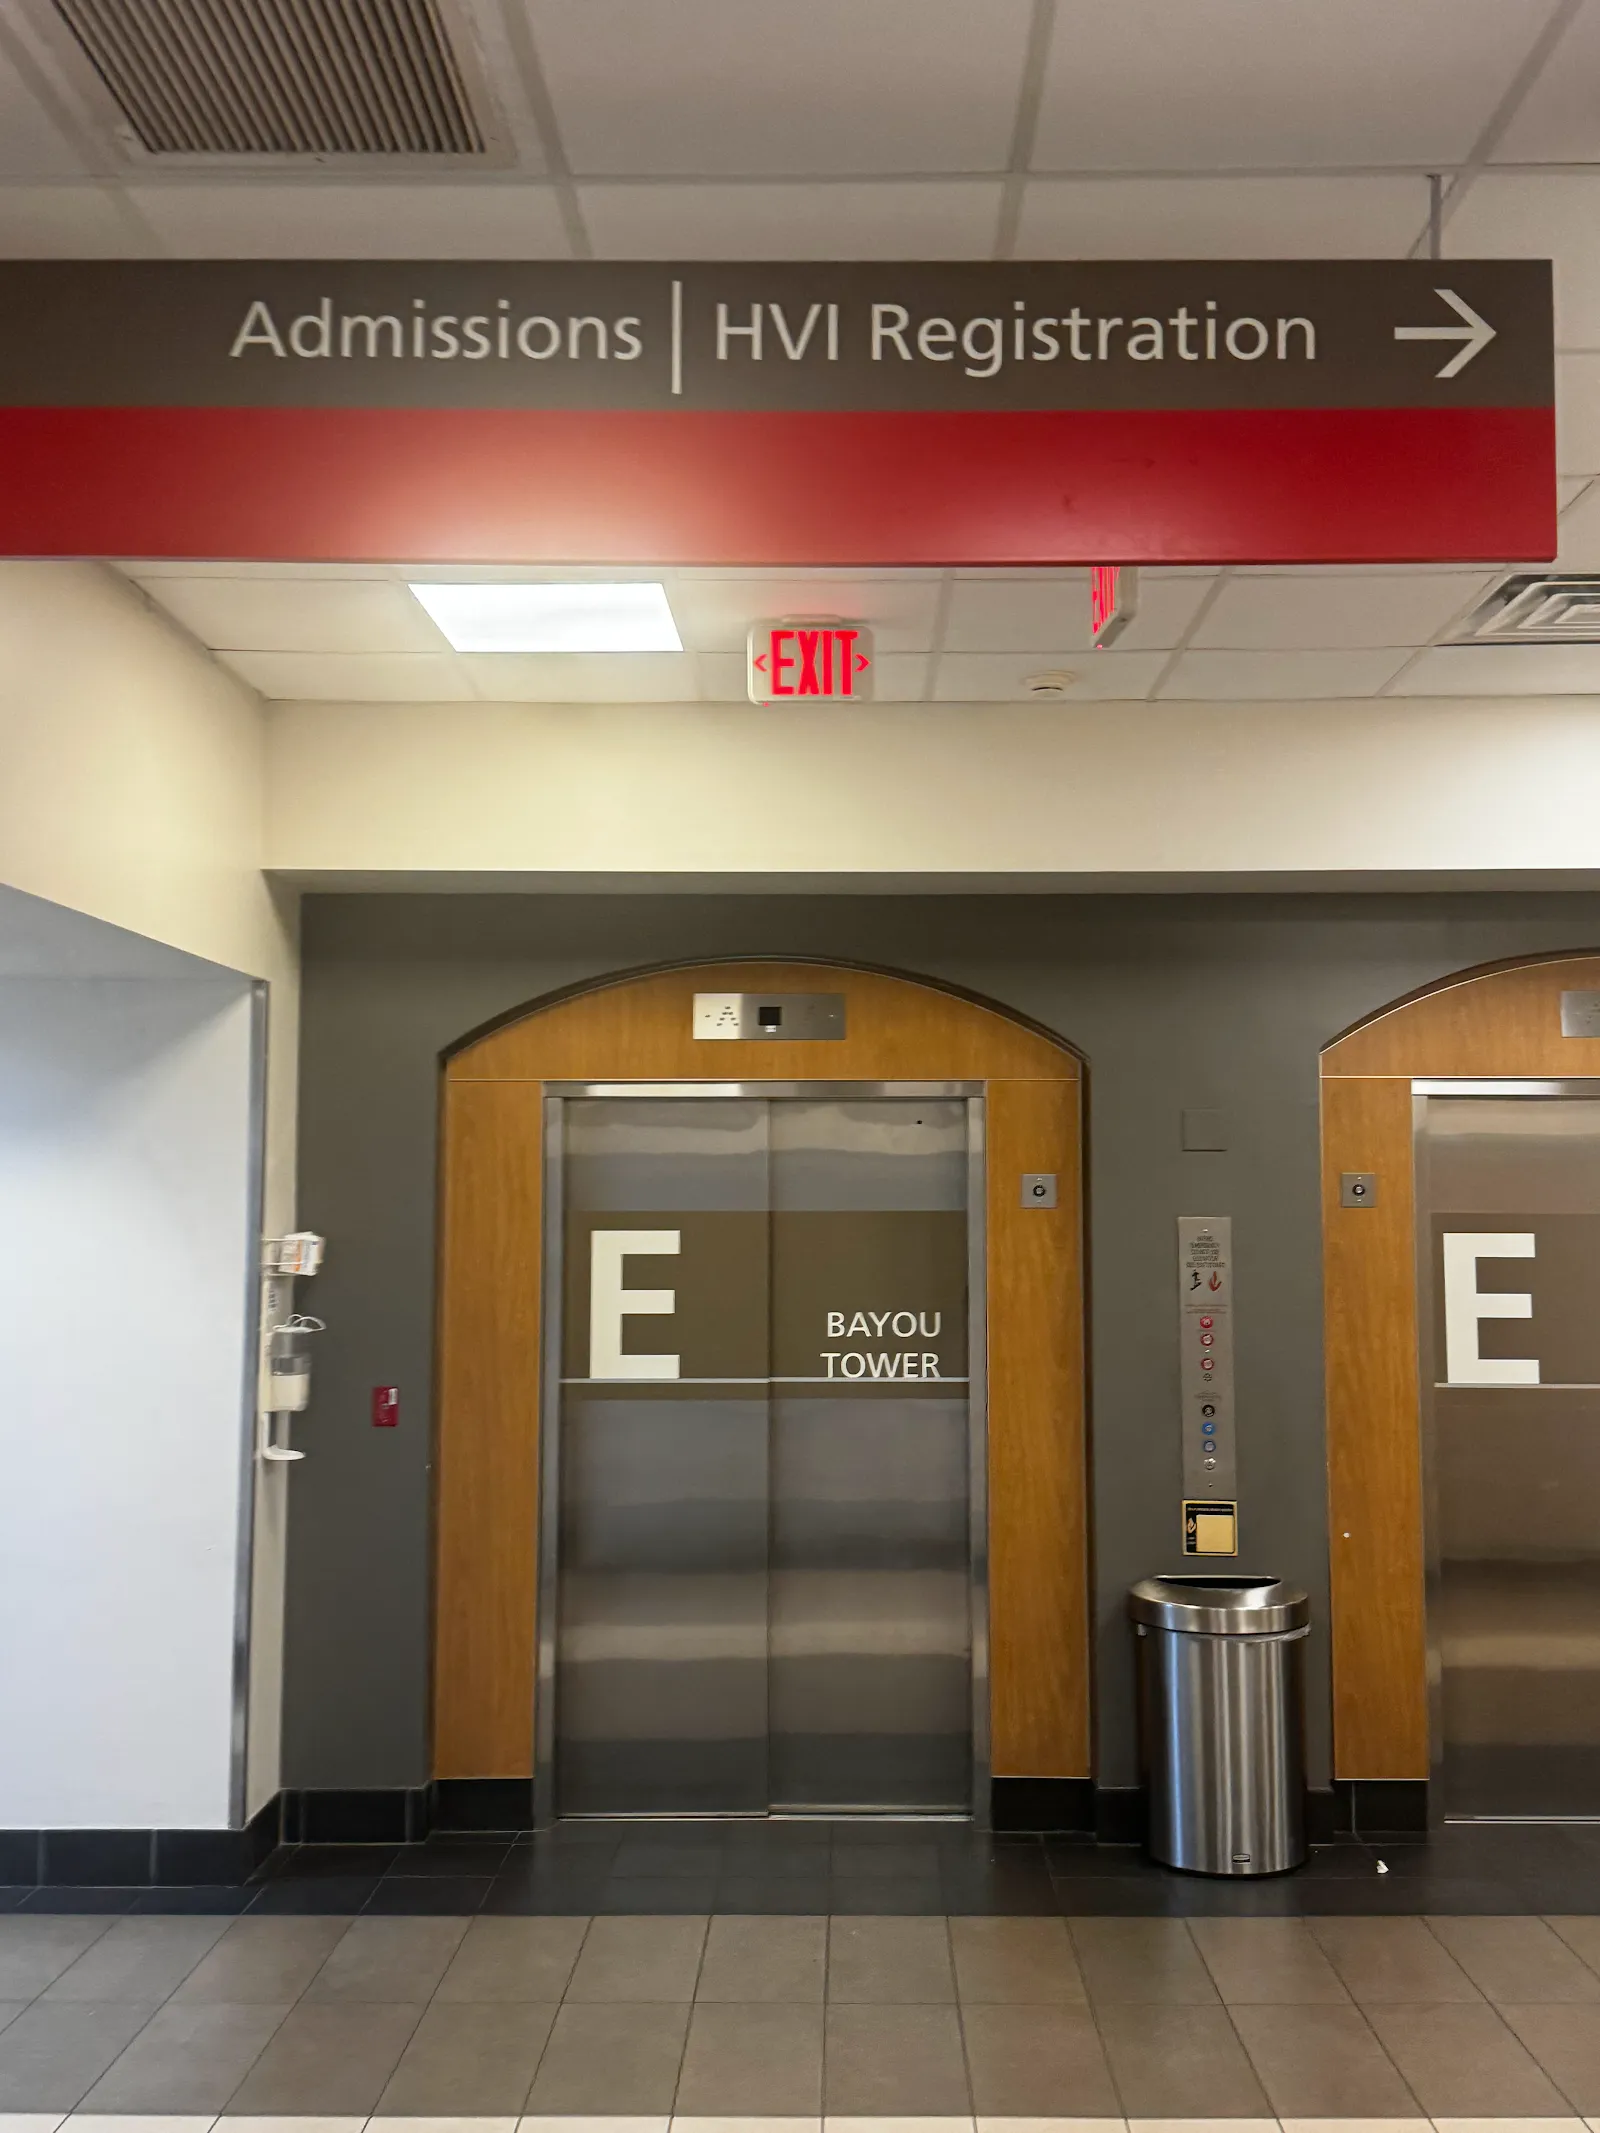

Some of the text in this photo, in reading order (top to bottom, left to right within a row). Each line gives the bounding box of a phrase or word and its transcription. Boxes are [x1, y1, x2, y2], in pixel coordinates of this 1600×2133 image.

[229, 298, 643, 361] Admissions
[716, 301, 1316, 378] HVI Registration
[770, 629, 859, 696] EXIT
[589, 1230, 681, 1380] E
[827, 1311, 942, 1338] BAYOU
[1442, 1232, 1540, 1384] E
[820, 1352, 941, 1378] TOWER
